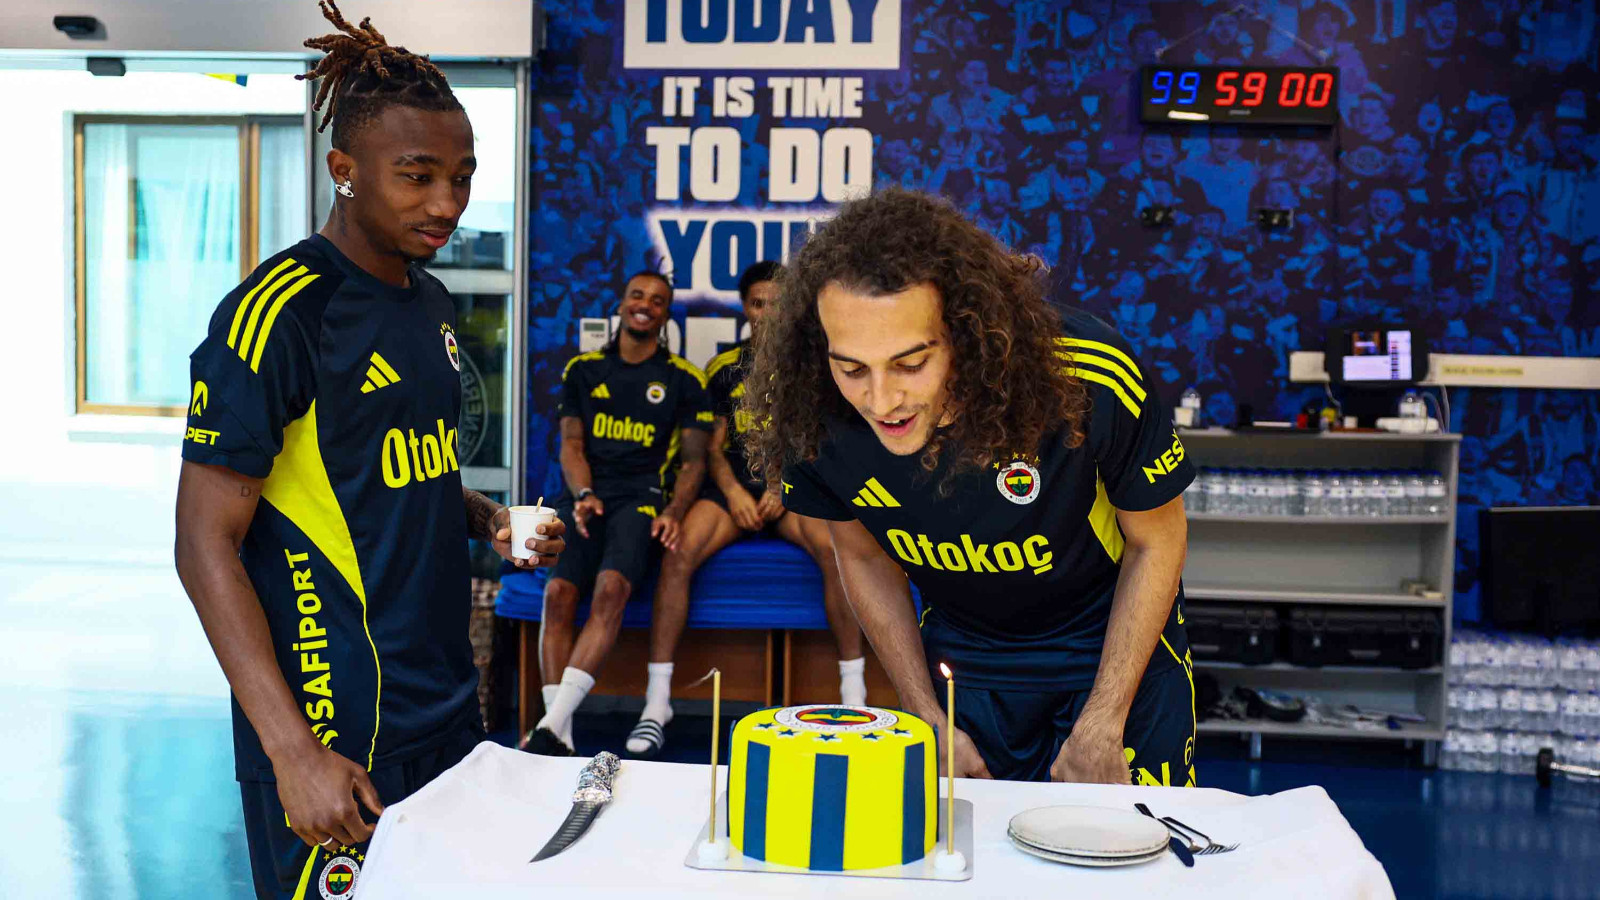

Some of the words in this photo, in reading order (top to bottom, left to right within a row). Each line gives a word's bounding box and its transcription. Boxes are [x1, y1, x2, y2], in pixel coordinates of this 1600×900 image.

[645, 0, 880, 44] TODAY
[662, 77, 700, 117] IT
[713, 77, 754, 117] IS
[768, 77, 863, 118] TIME
[1151, 71, 1201, 105] 99
[1214, 71, 1268, 106] 59
[1278, 72, 1333, 107] 00
[646, 127, 741, 202] TO
[769, 128, 873, 203] DO
[659, 219, 815, 290] YOU
[382, 418, 460, 489] Otok
[1142, 428, 1185, 484] NES
[886, 528, 1053, 576] Otokoç
[285, 549, 335, 720] SAFİPORT
